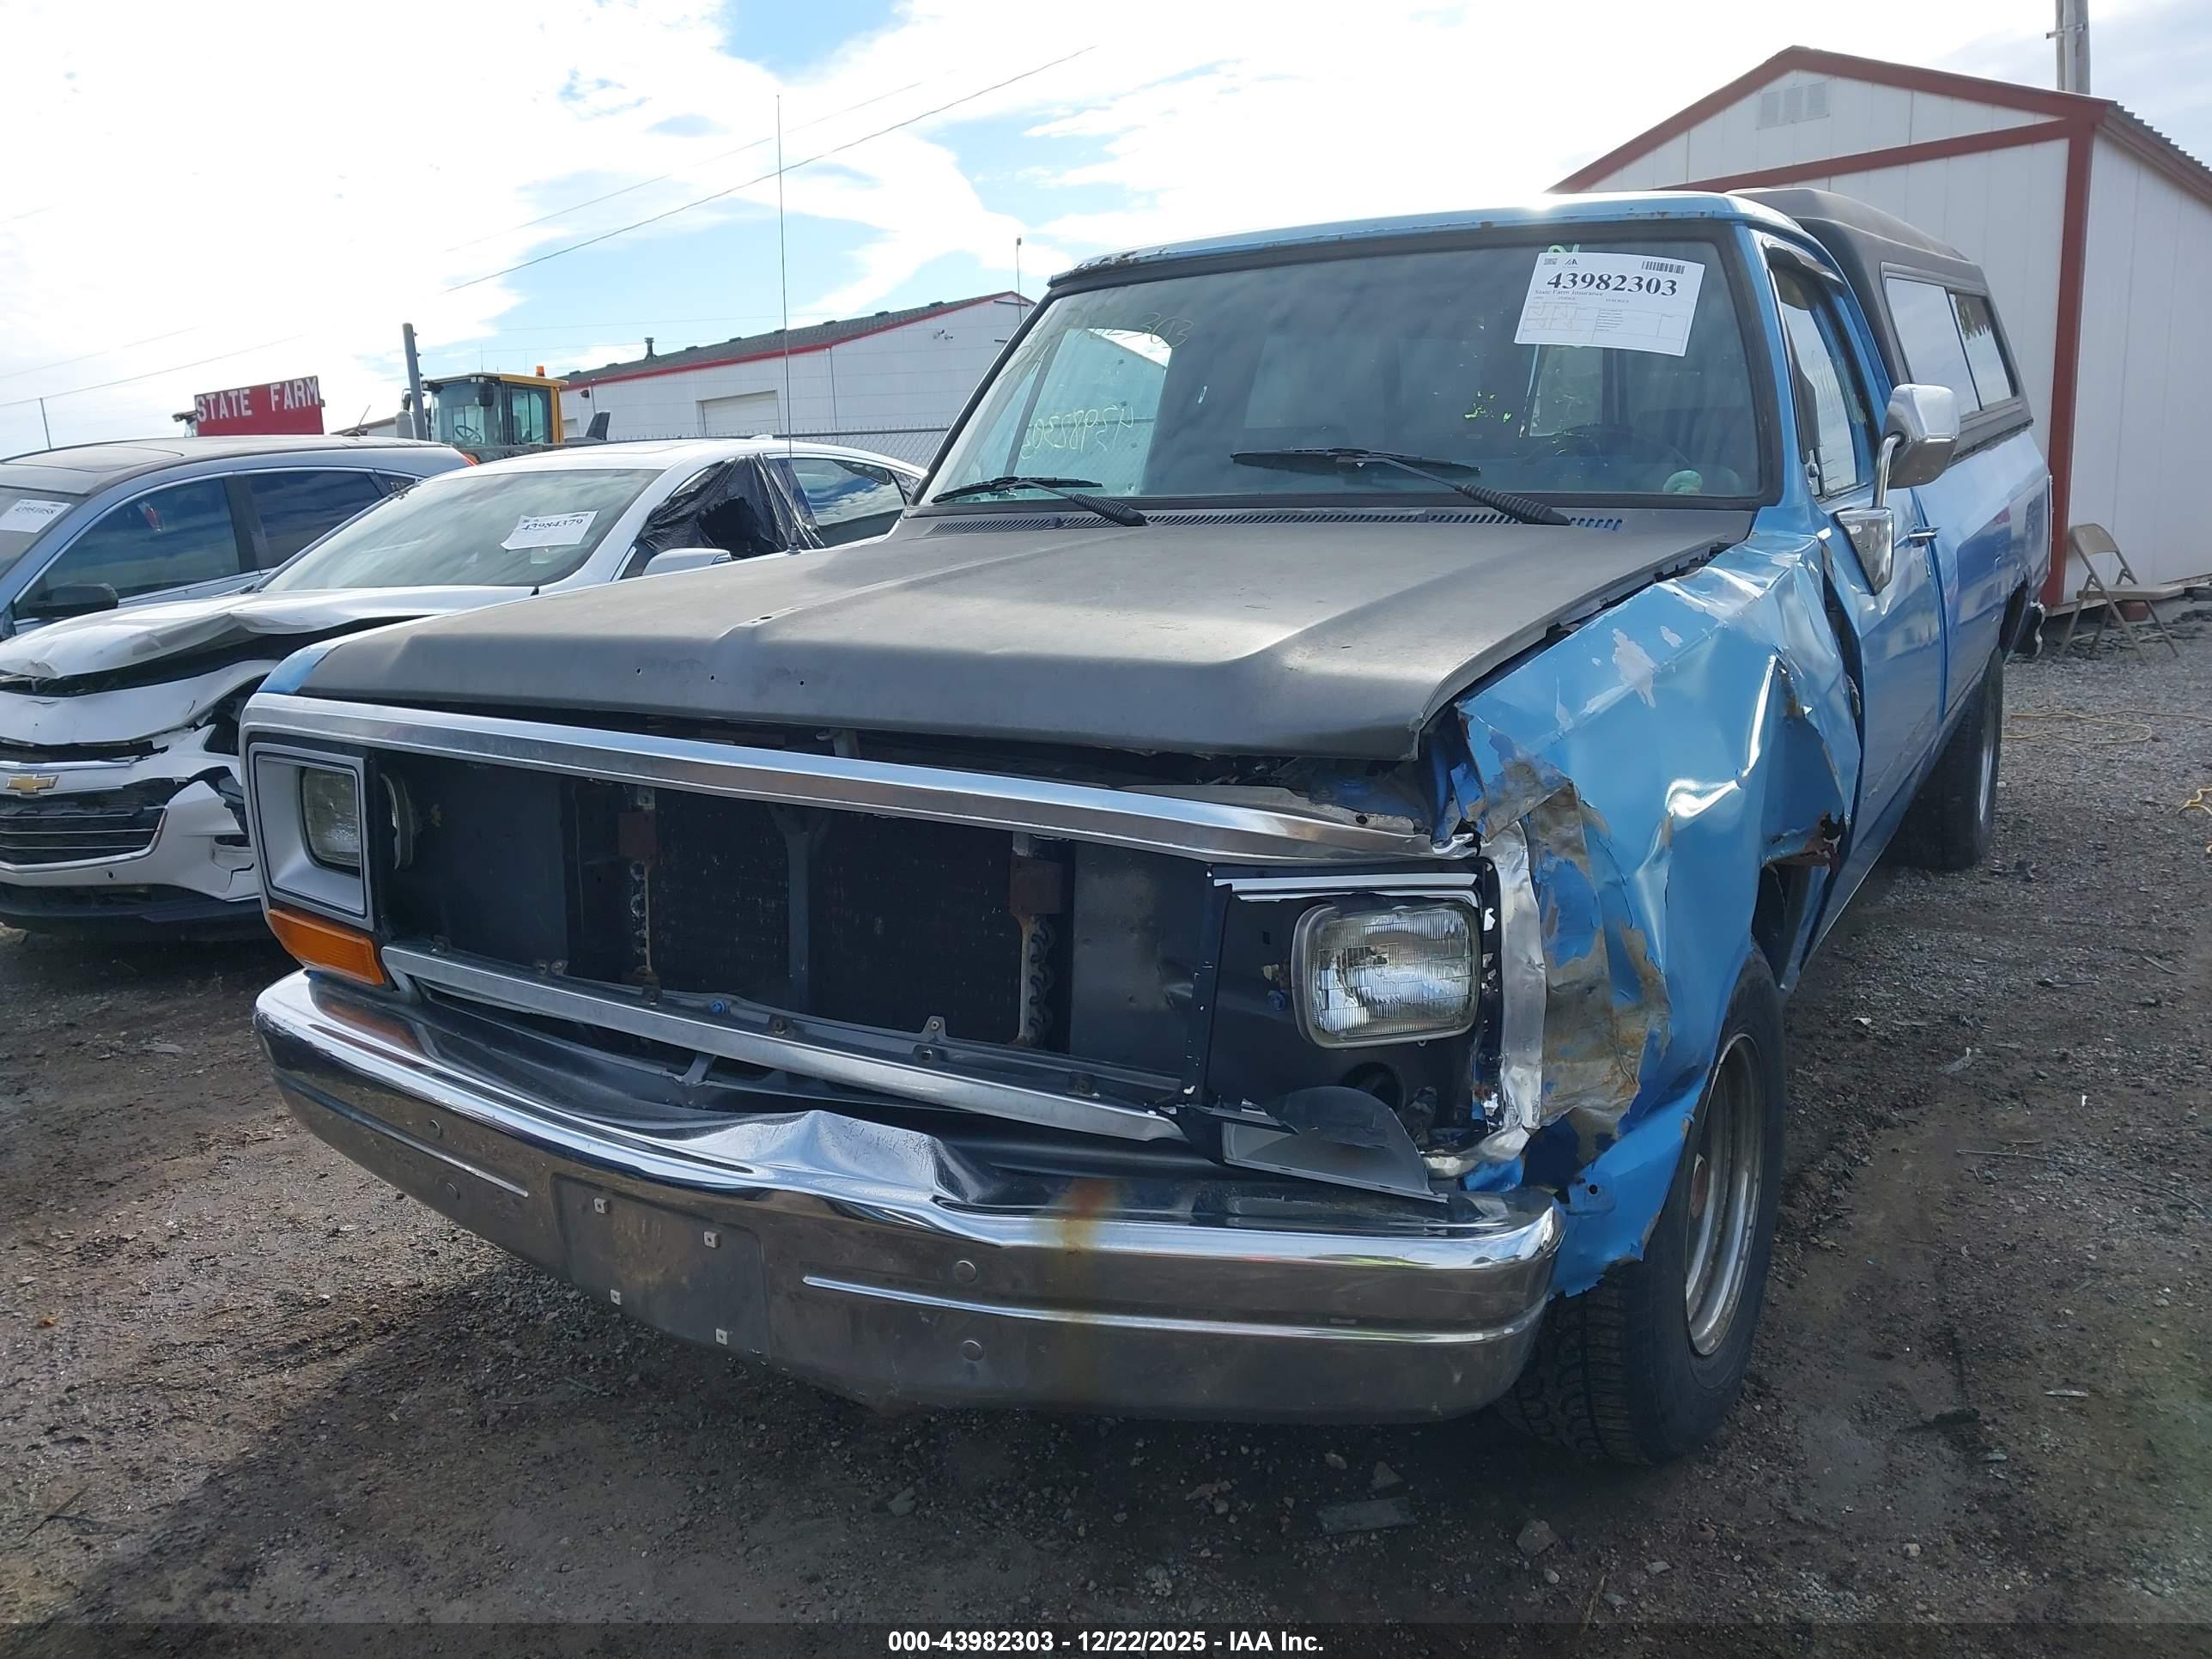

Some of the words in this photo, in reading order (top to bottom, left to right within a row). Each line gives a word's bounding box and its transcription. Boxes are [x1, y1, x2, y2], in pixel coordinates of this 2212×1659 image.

[1547, 271, 1677, 296] 43982303
[195, 388, 252, 422] STATE
[270, 377, 319, 411] FARM
